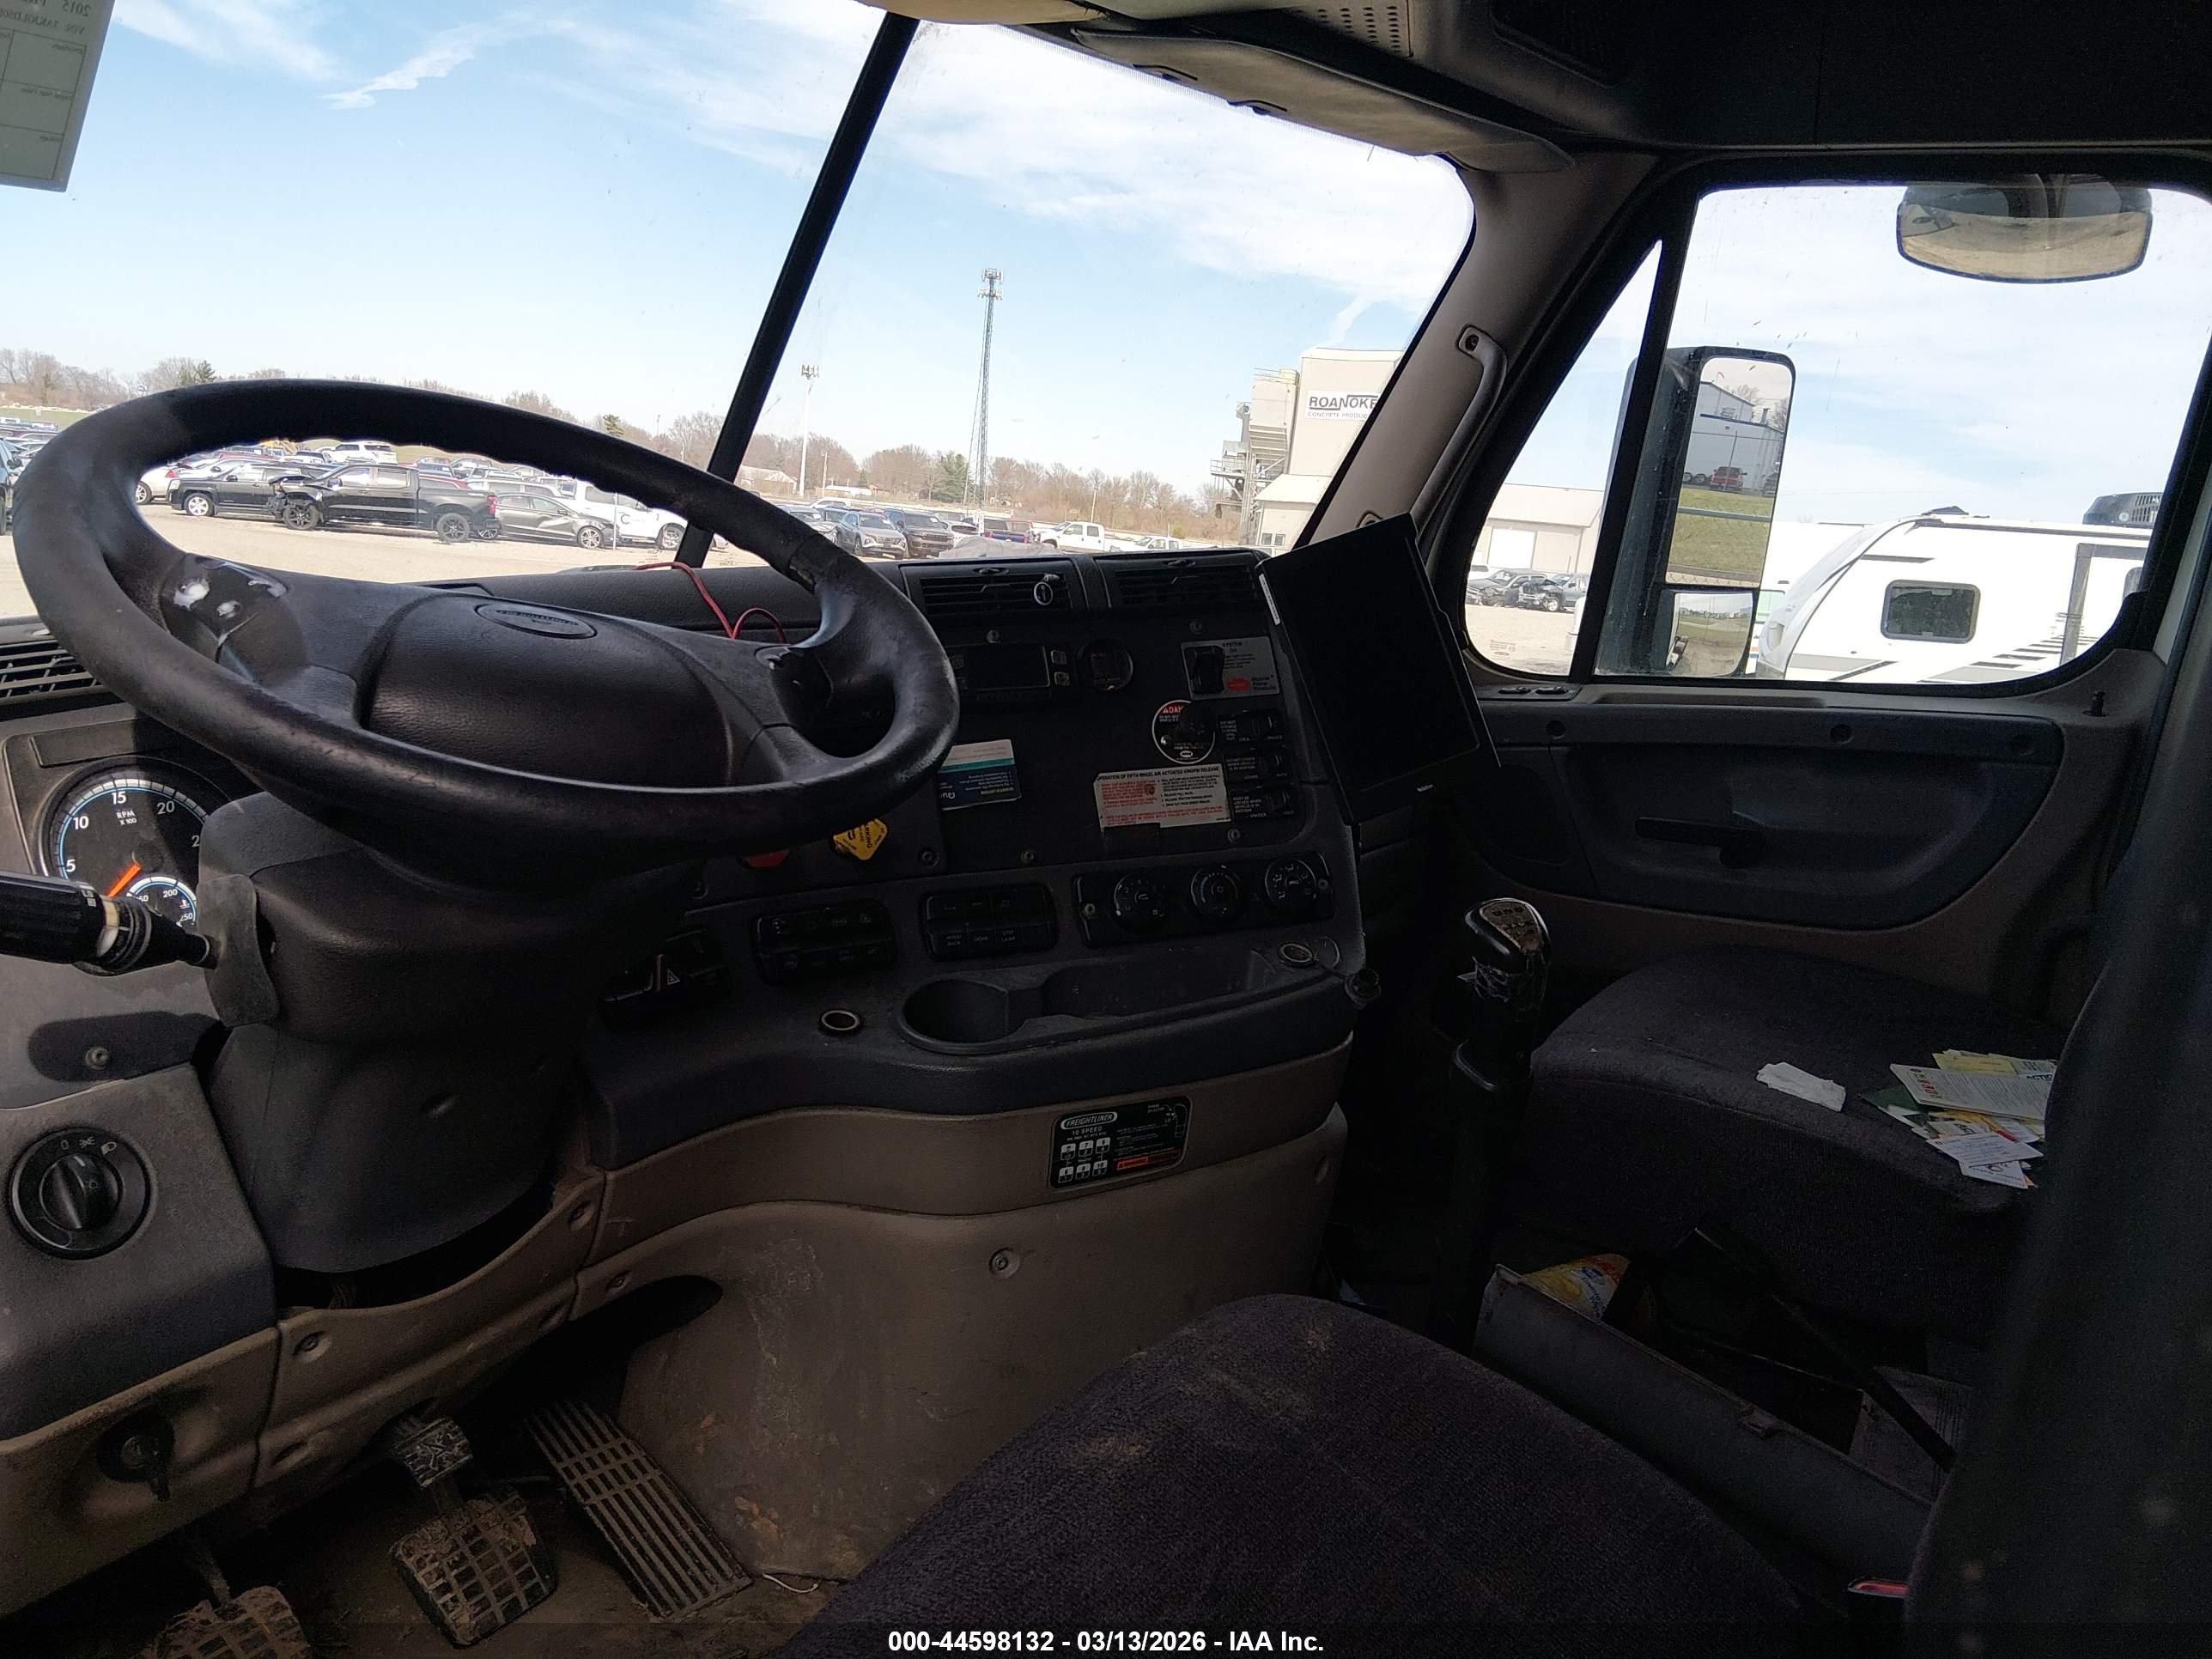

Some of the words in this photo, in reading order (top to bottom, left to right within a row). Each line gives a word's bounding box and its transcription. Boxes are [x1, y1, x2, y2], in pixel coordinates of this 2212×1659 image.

[112, 791, 126, 805] 15
[116, 810, 136, 819] RPM
[156, 801, 176, 815] 20
[73, 816, 89, 830] 10
[191, 834, 200, 848] 2
[66, 859, 76, 872] 5
[162, 889, 178, 898] 200
[1066, 1114, 1114, 1127] FREIGHTLINER
[1081, 1126, 1103, 1134] SPEED
